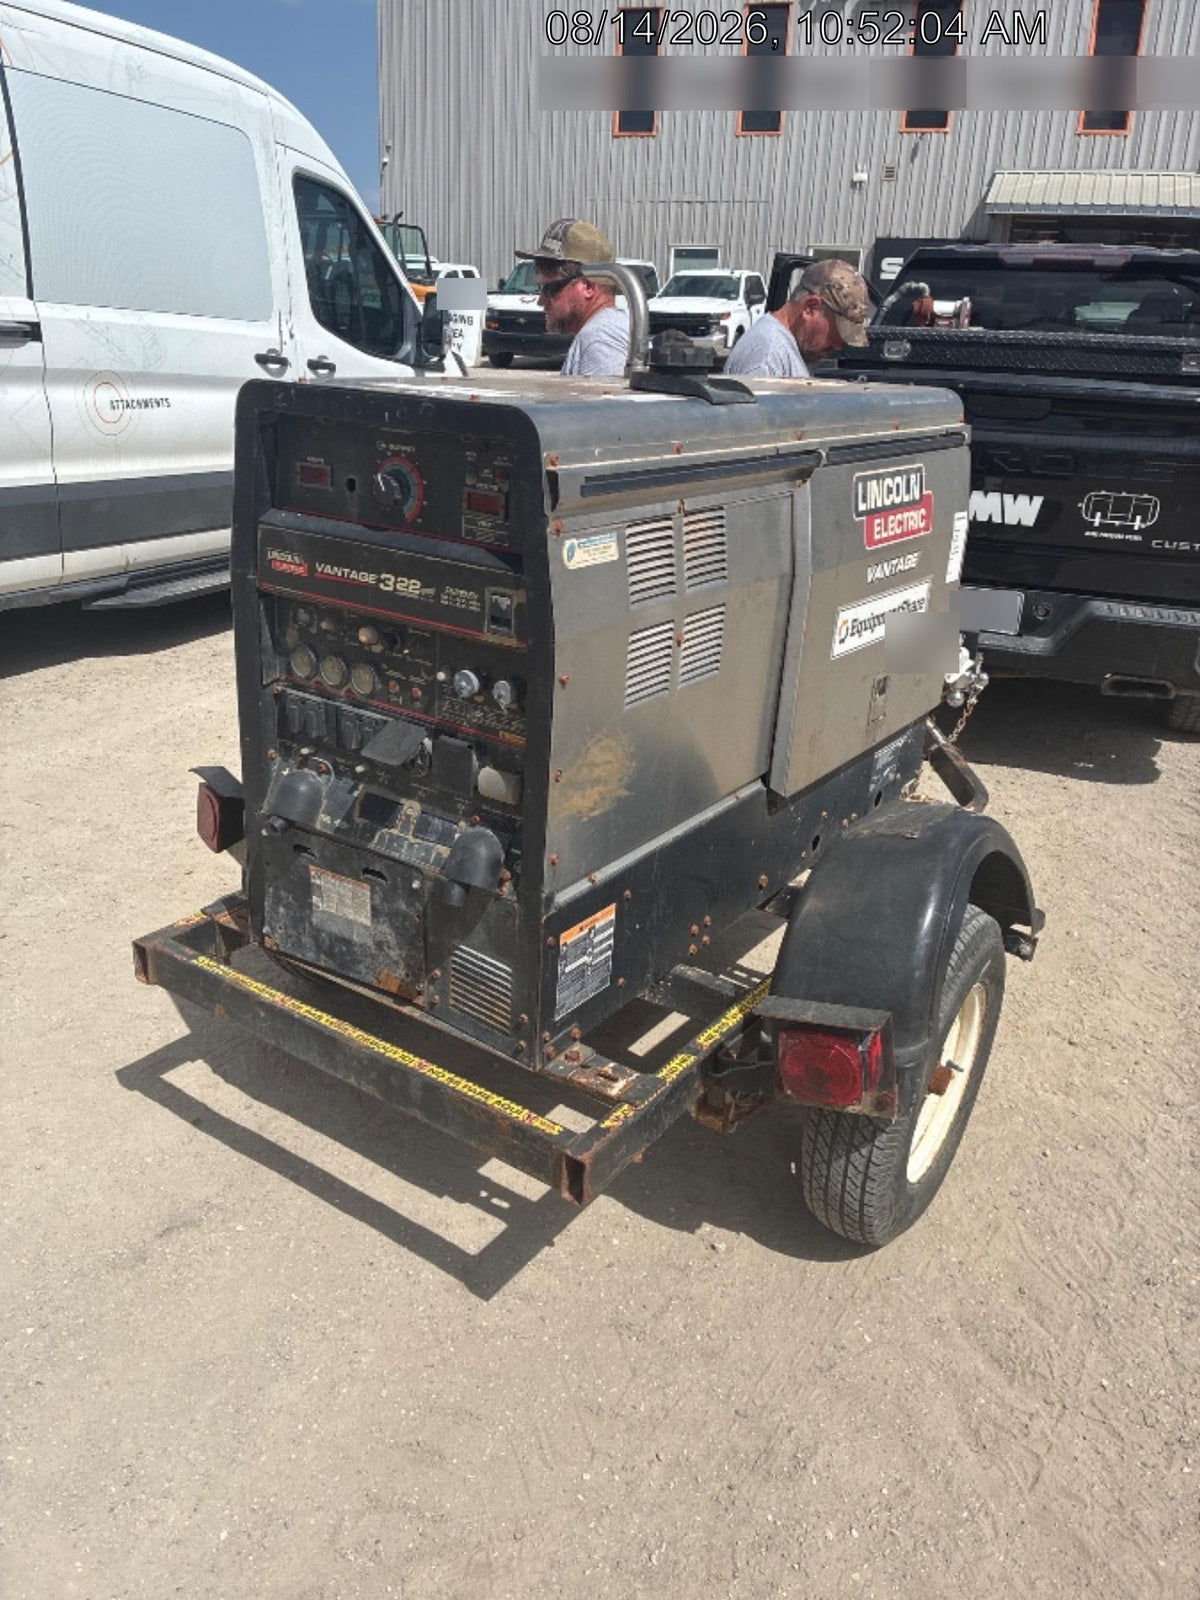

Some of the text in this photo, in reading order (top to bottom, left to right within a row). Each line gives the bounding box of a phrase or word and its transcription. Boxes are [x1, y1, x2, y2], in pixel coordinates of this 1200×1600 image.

[857, 472, 921, 512] LINCOLN
[873, 508, 927, 541] ELECTRIC
[315, 561, 379, 585] VANTAGE
[379, 572, 422, 596] 322
[867, 551, 921, 583] VANTAGE
